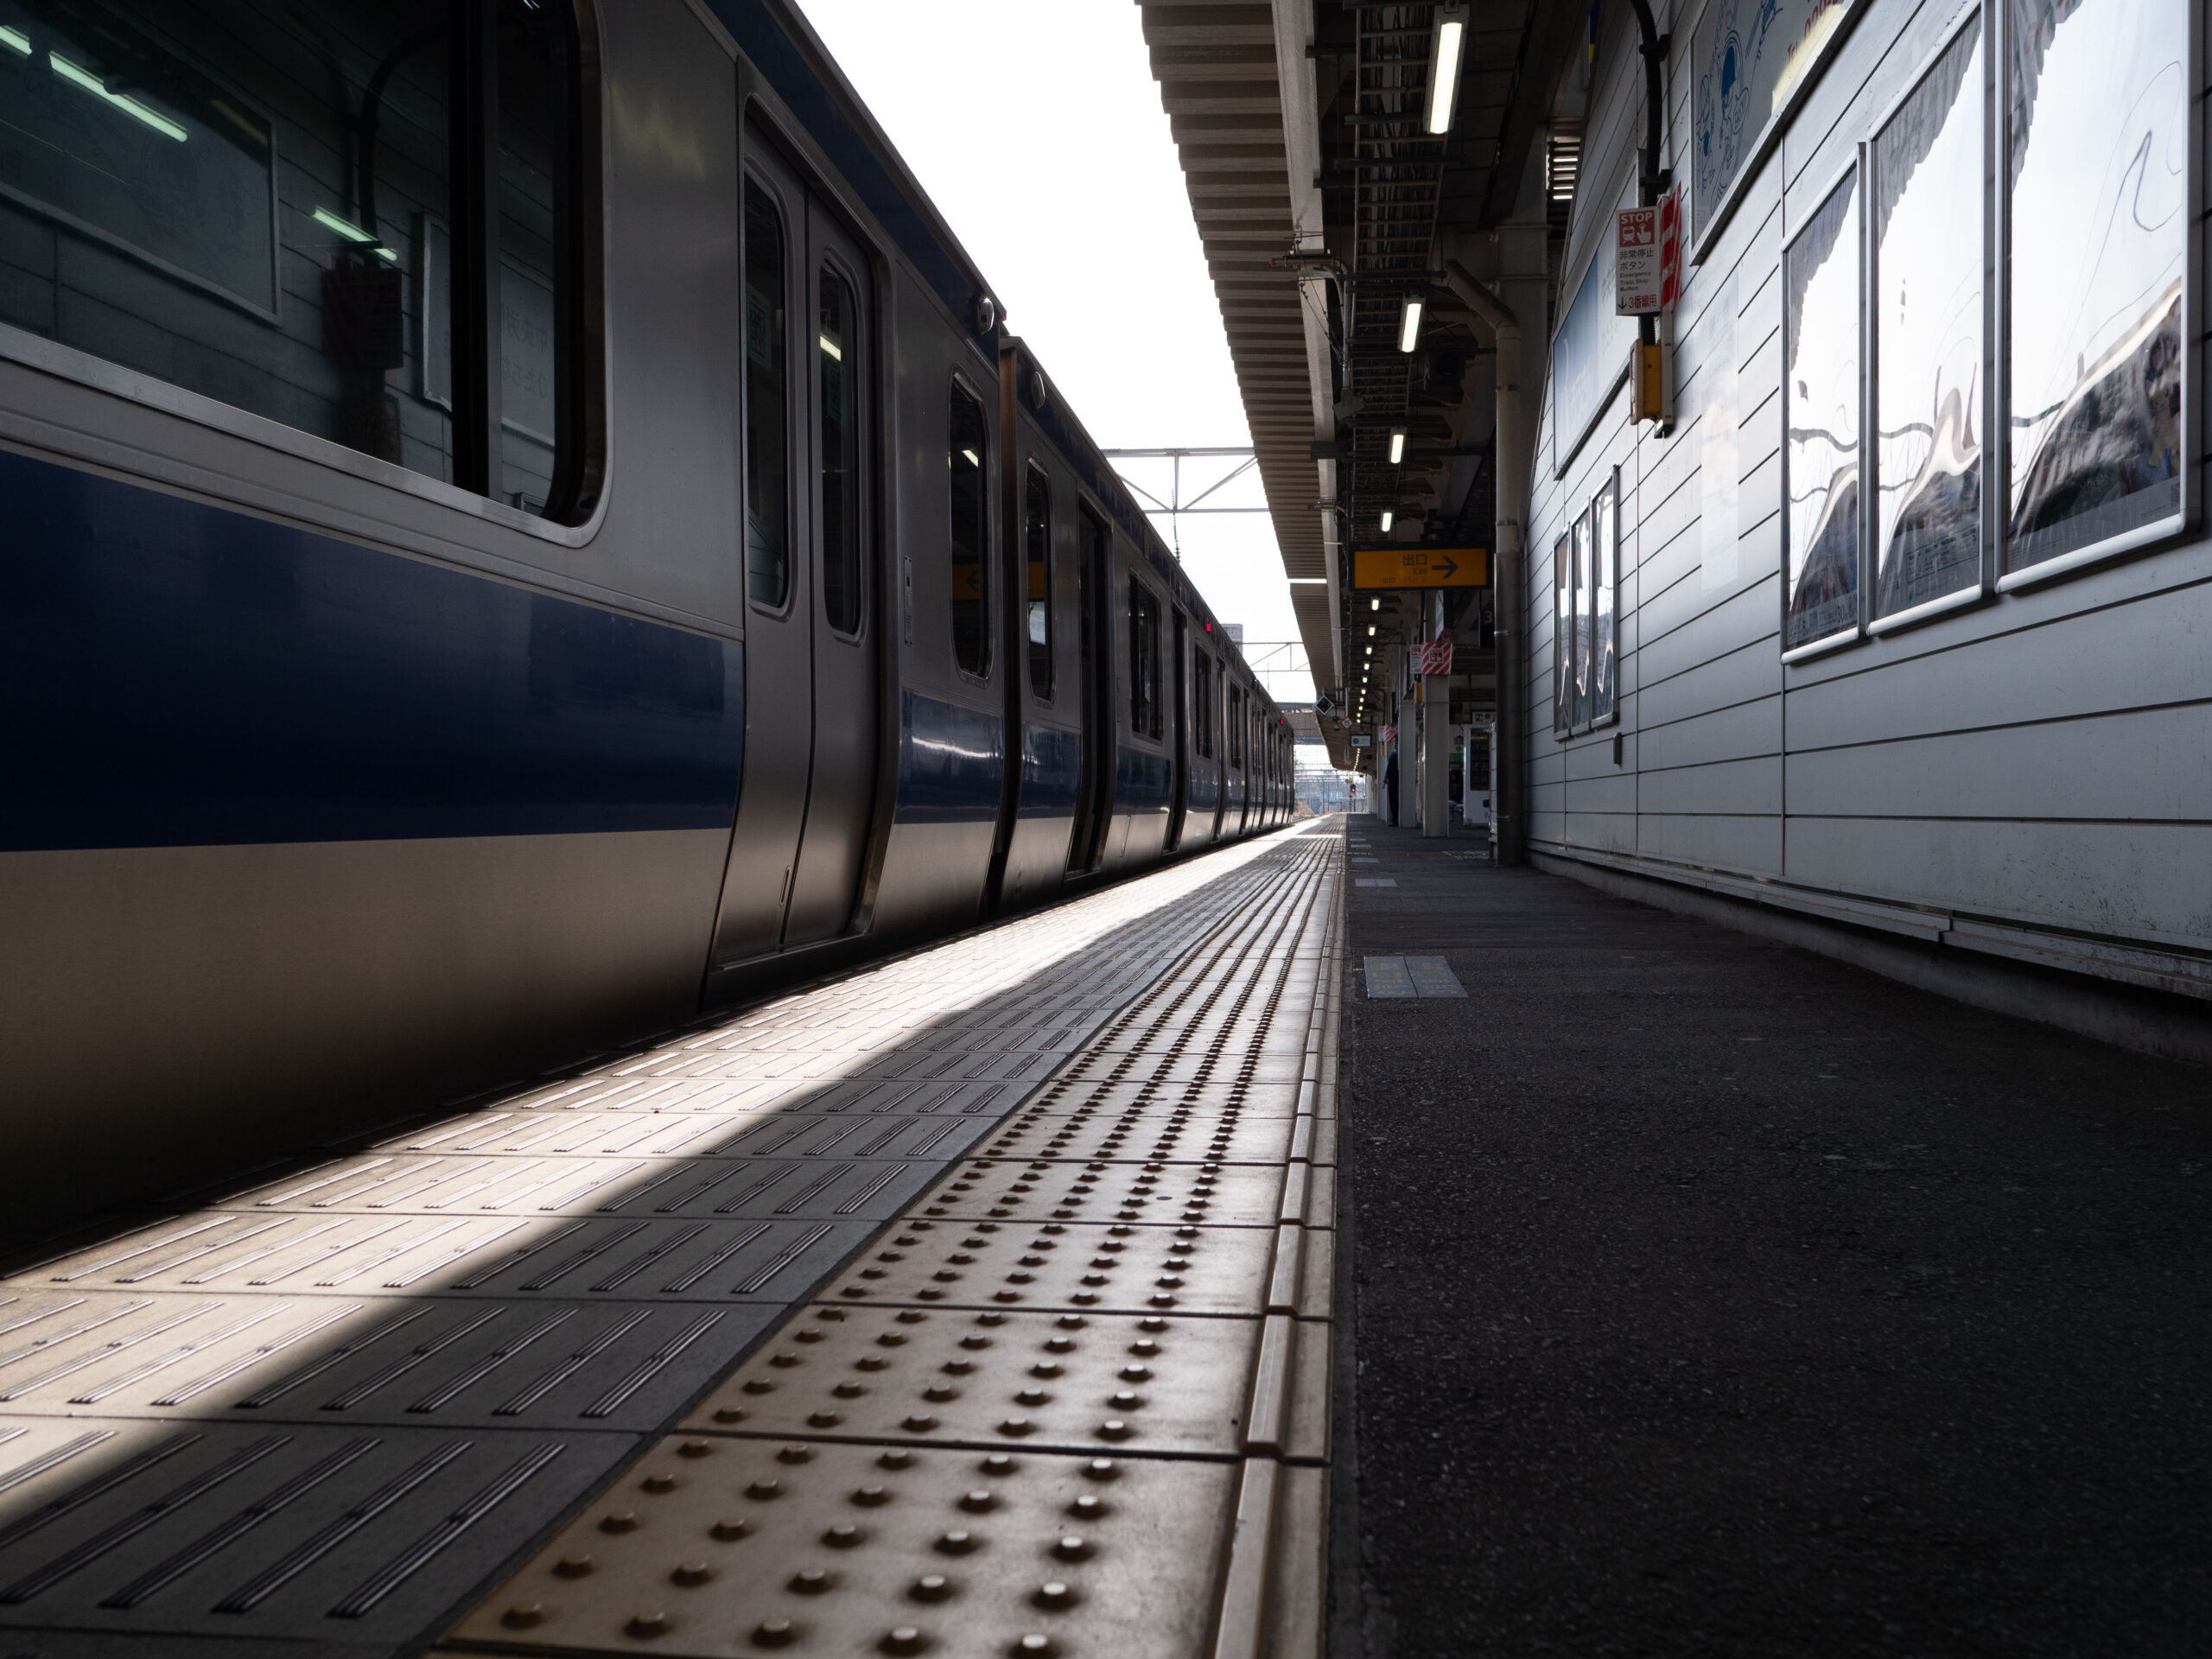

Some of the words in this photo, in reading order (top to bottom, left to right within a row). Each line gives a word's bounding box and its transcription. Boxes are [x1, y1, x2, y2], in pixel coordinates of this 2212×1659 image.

[1620, 212, 1653, 224] STOP
[1619, 248, 1655, 259] 非常停止
[1619, 260, 1646, 270] ボタン
[1628, 294, 1657, 309] 3番線用
[1402, 553, 1427, 566] 出口
[1485, 610, 1493, 623] 3
